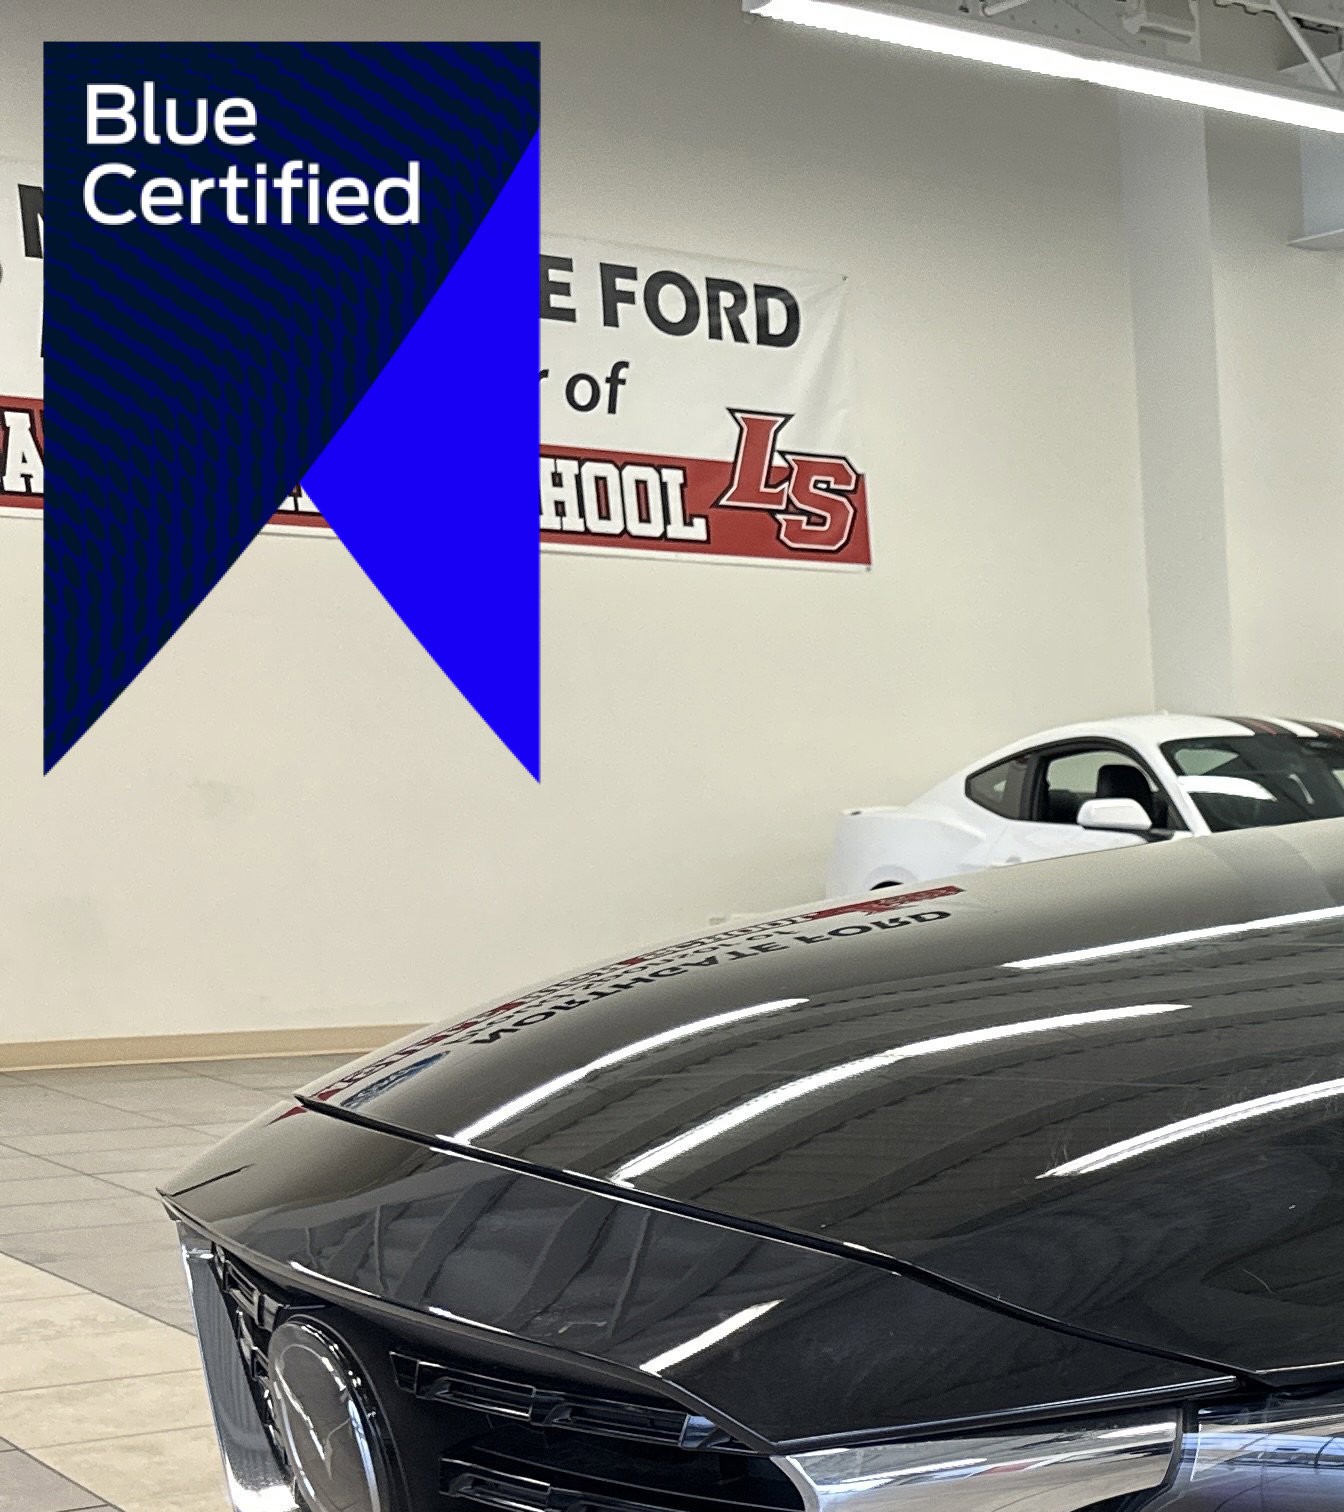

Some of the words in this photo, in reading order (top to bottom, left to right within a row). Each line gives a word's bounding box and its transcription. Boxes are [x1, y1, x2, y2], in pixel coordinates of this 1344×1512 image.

[599, 262, 801, 348] FORD
[565, 361, 630, 415] of
[540, 456, 708, 542] HOOL
